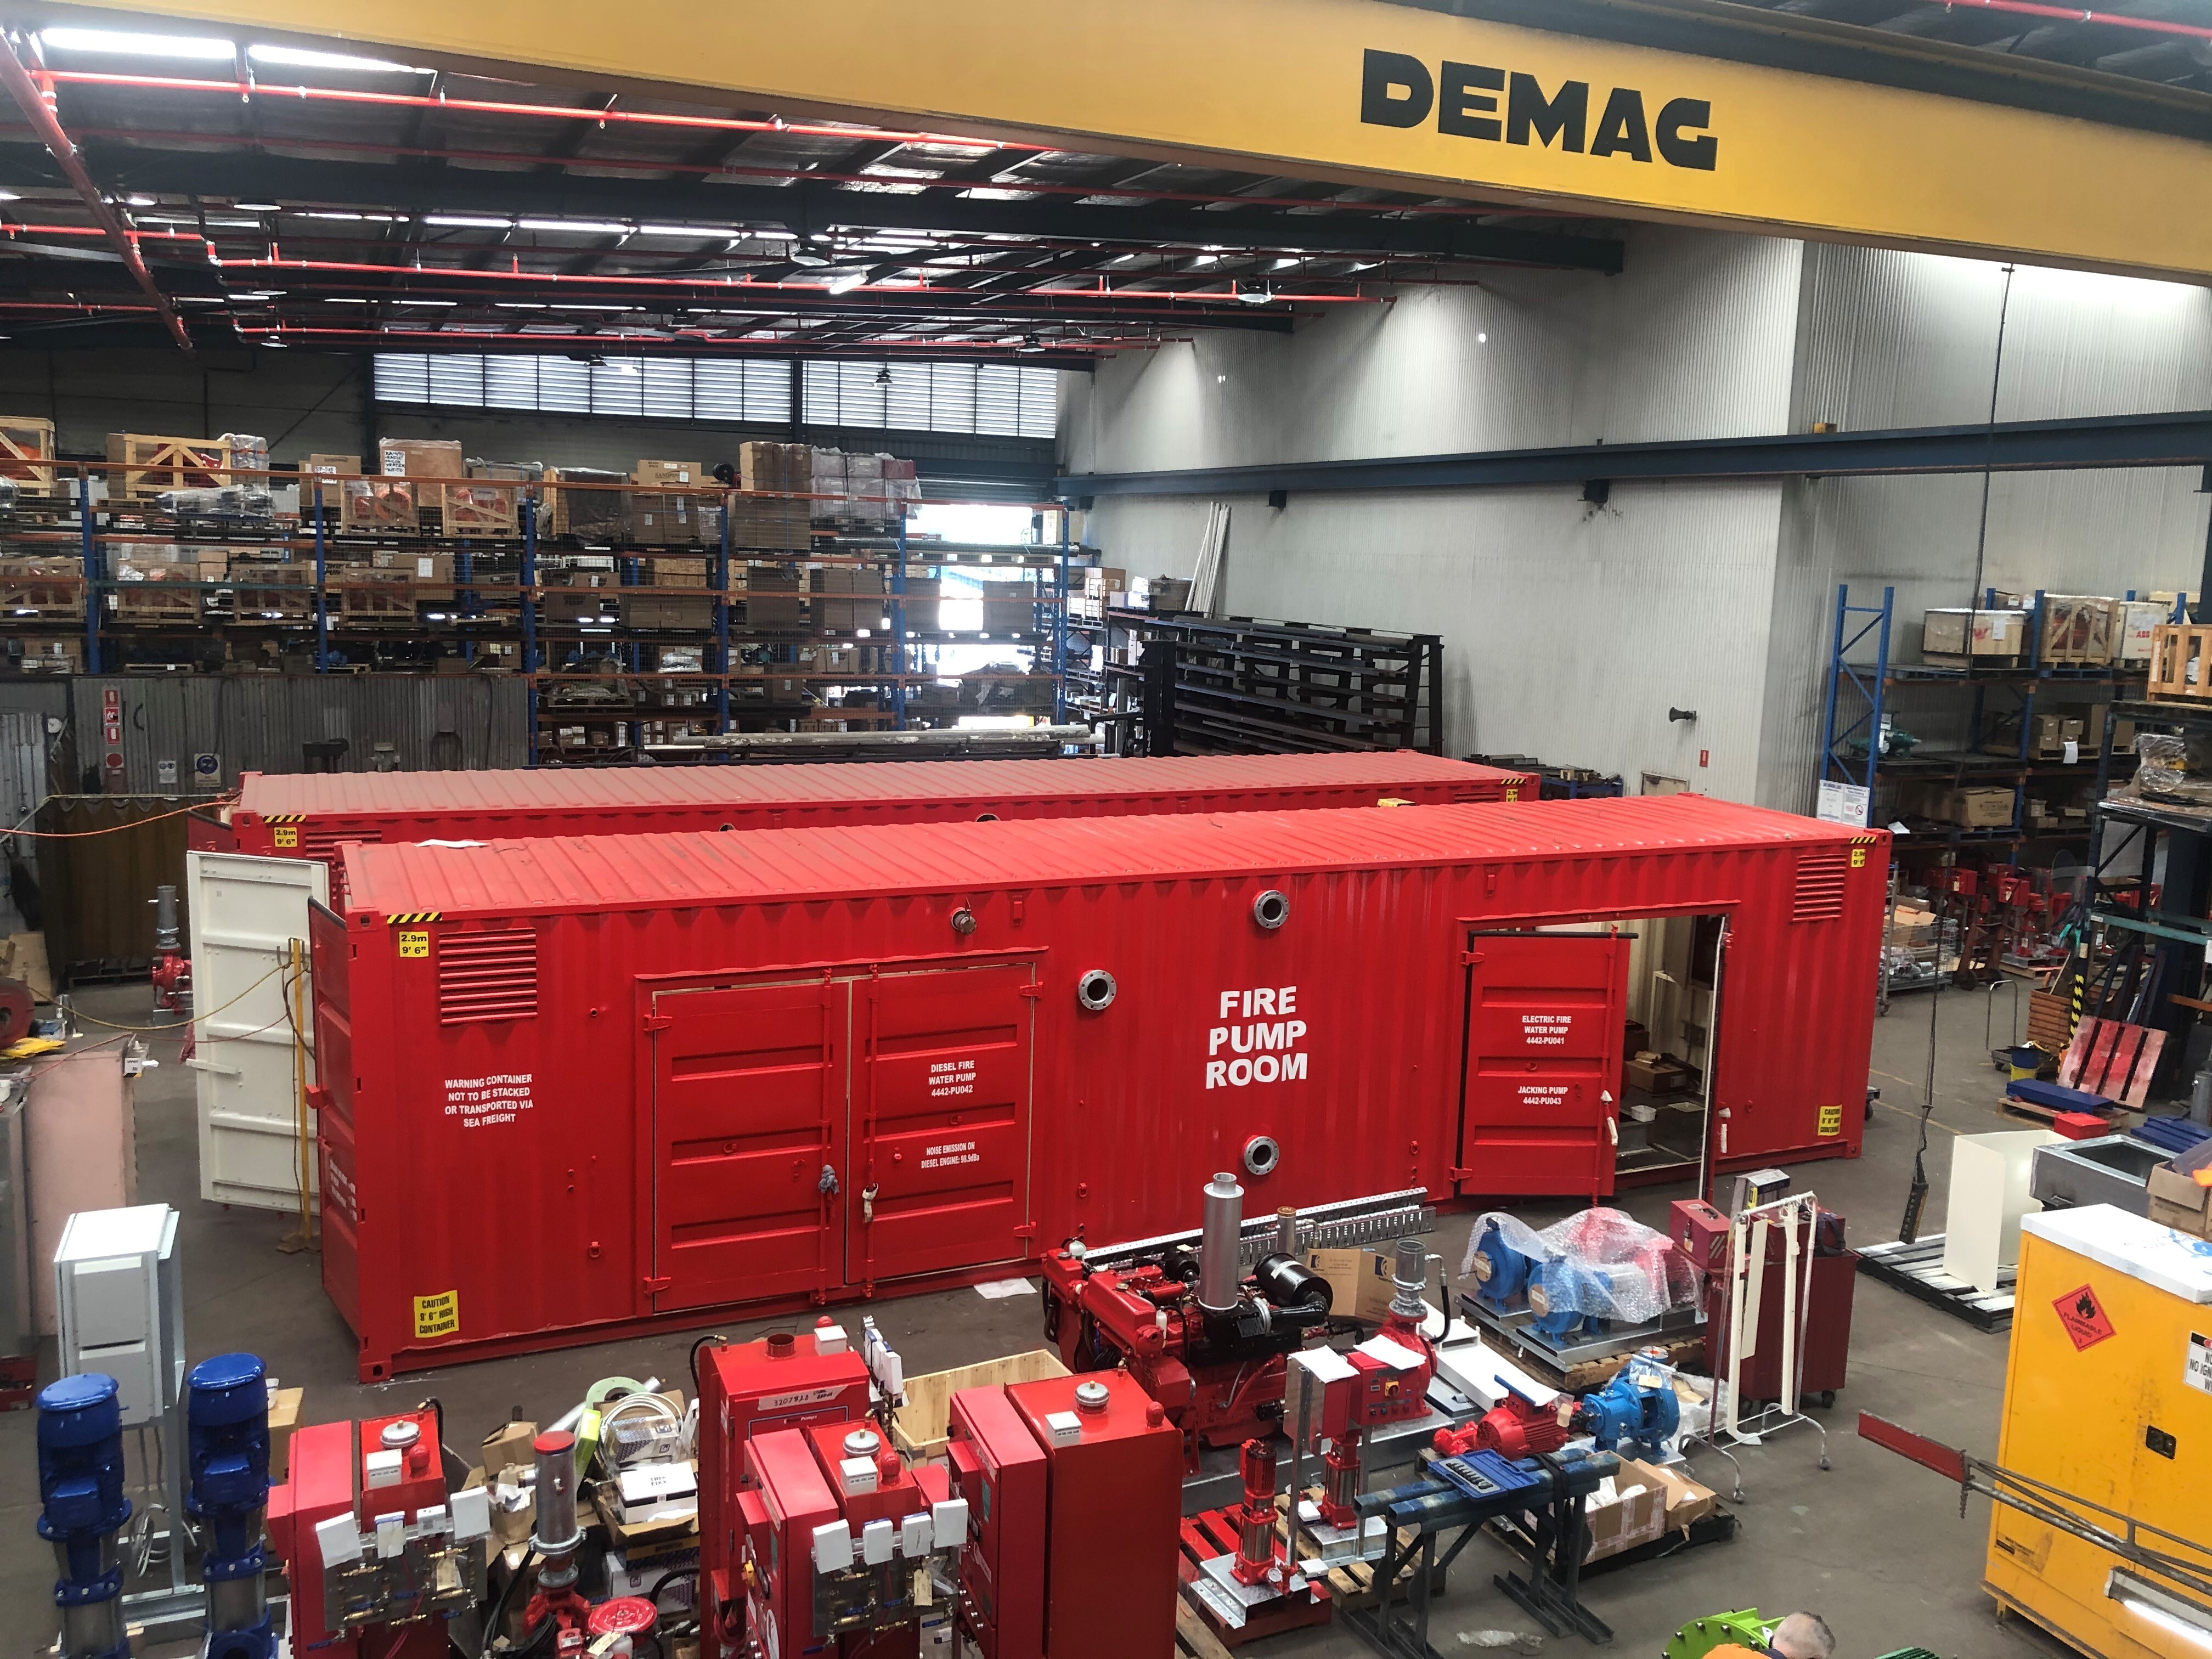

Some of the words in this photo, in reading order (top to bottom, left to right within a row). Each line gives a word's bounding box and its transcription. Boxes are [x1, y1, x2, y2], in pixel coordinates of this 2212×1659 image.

[1361, 48, 1718, 171] DEMAG
[401, 934, 427, 943] 2.9m
[1220, 986, 1297, 1019] FIRE
[1209, 1020, 1307, 1056] PUMP
[1526, 1036, 1565, 1045] 4442-PU041
[931, 1062, 957, 1073] DIESEL
[958, 1060, 975, 1070] FIRE
[1206, 1053, 1308, 1090] ROOM
[445, 1078, 485, 1089] WARNING
[486, 1074, 532, 1086] CONTAINER
[929, 1075, 954, 1085] WATER
[956, 1072, 977, 1082] PUMP
[448, 1092, 466, 1102] NOT
[467, 1092, 479, 1101] TO
[481, 1090, 491, 1101] BE
[493, 1087, 531, 1097] STACKED
[931, 1085, 973, 1097] 4442-PU042
[445, 1105, 457, 1115] OR
[459, 1101, 517, 1114] TRANSPORTED
[520, 1099, 533, 1109] VIA
[464, 1118, 480, 1127] SEA
[482, 1113, 516, 1126] FREIGHT
[926, 1146, 942, 1156] NOISE
[943, 1142, 967, 1154] EMISSION
[968, 1141, 975, 1150] ON
[921, 1159, 939, 1169] DIESEL
[940, 1155, 960, 1166] ENGINE:
[422, 1295, 450, 1309] CAUTION
[439, 1307, 453, 1319] HIGH
[419, 1319, 455, 1334] CONTAINER
[2064, 1312, 2102, 1335] FLAMMABLE
[2071, 1324, 2092, 1338] LIQUID
[2190, 1358, 2199, 1372] NO
